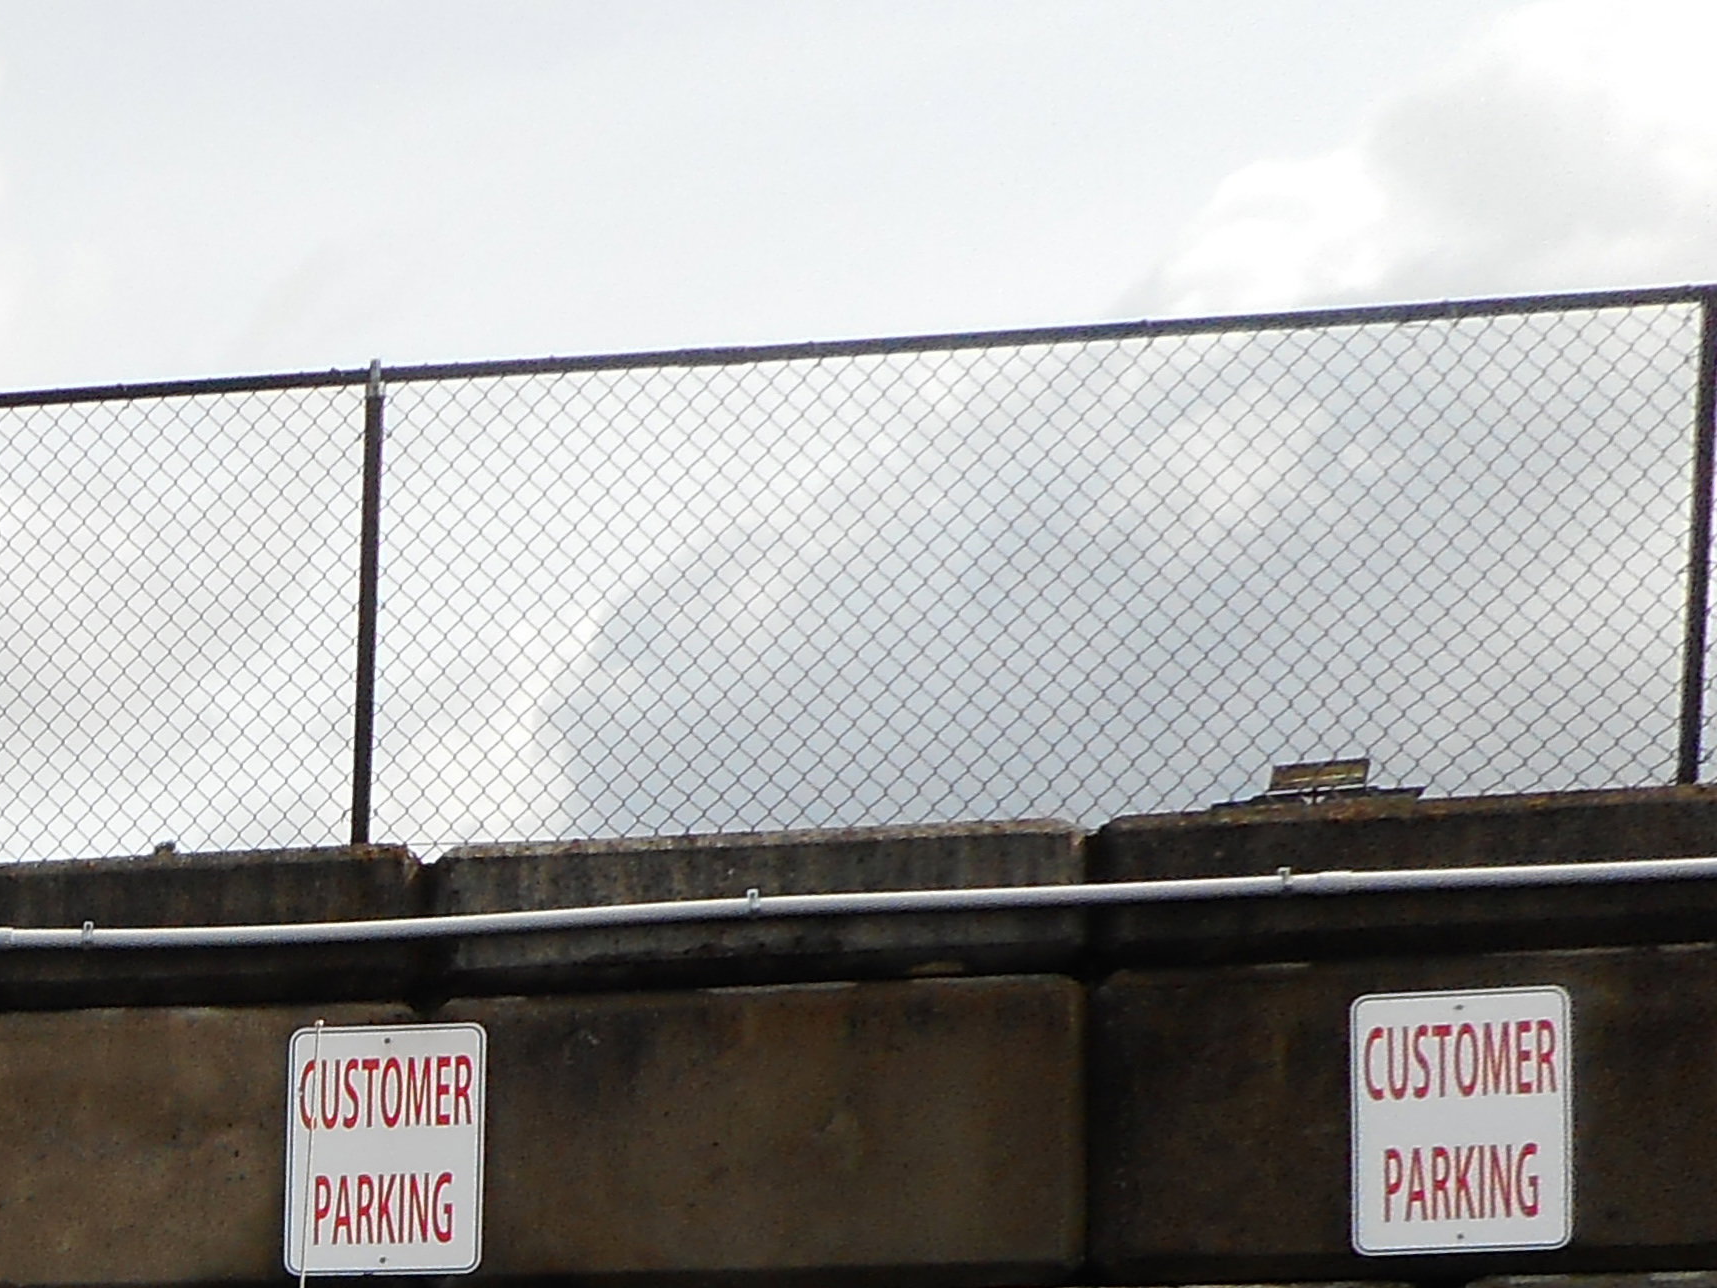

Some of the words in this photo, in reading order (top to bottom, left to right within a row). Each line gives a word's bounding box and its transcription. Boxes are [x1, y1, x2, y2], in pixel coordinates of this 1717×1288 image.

[300, 1054, 475, 1130] CUSTOMER
[1365, 1020, 1558, 1100] CUSTOMER
[313, 1172, 454, 1245] PARKING
[1383, 1142, 1541, 1221] PARKING
